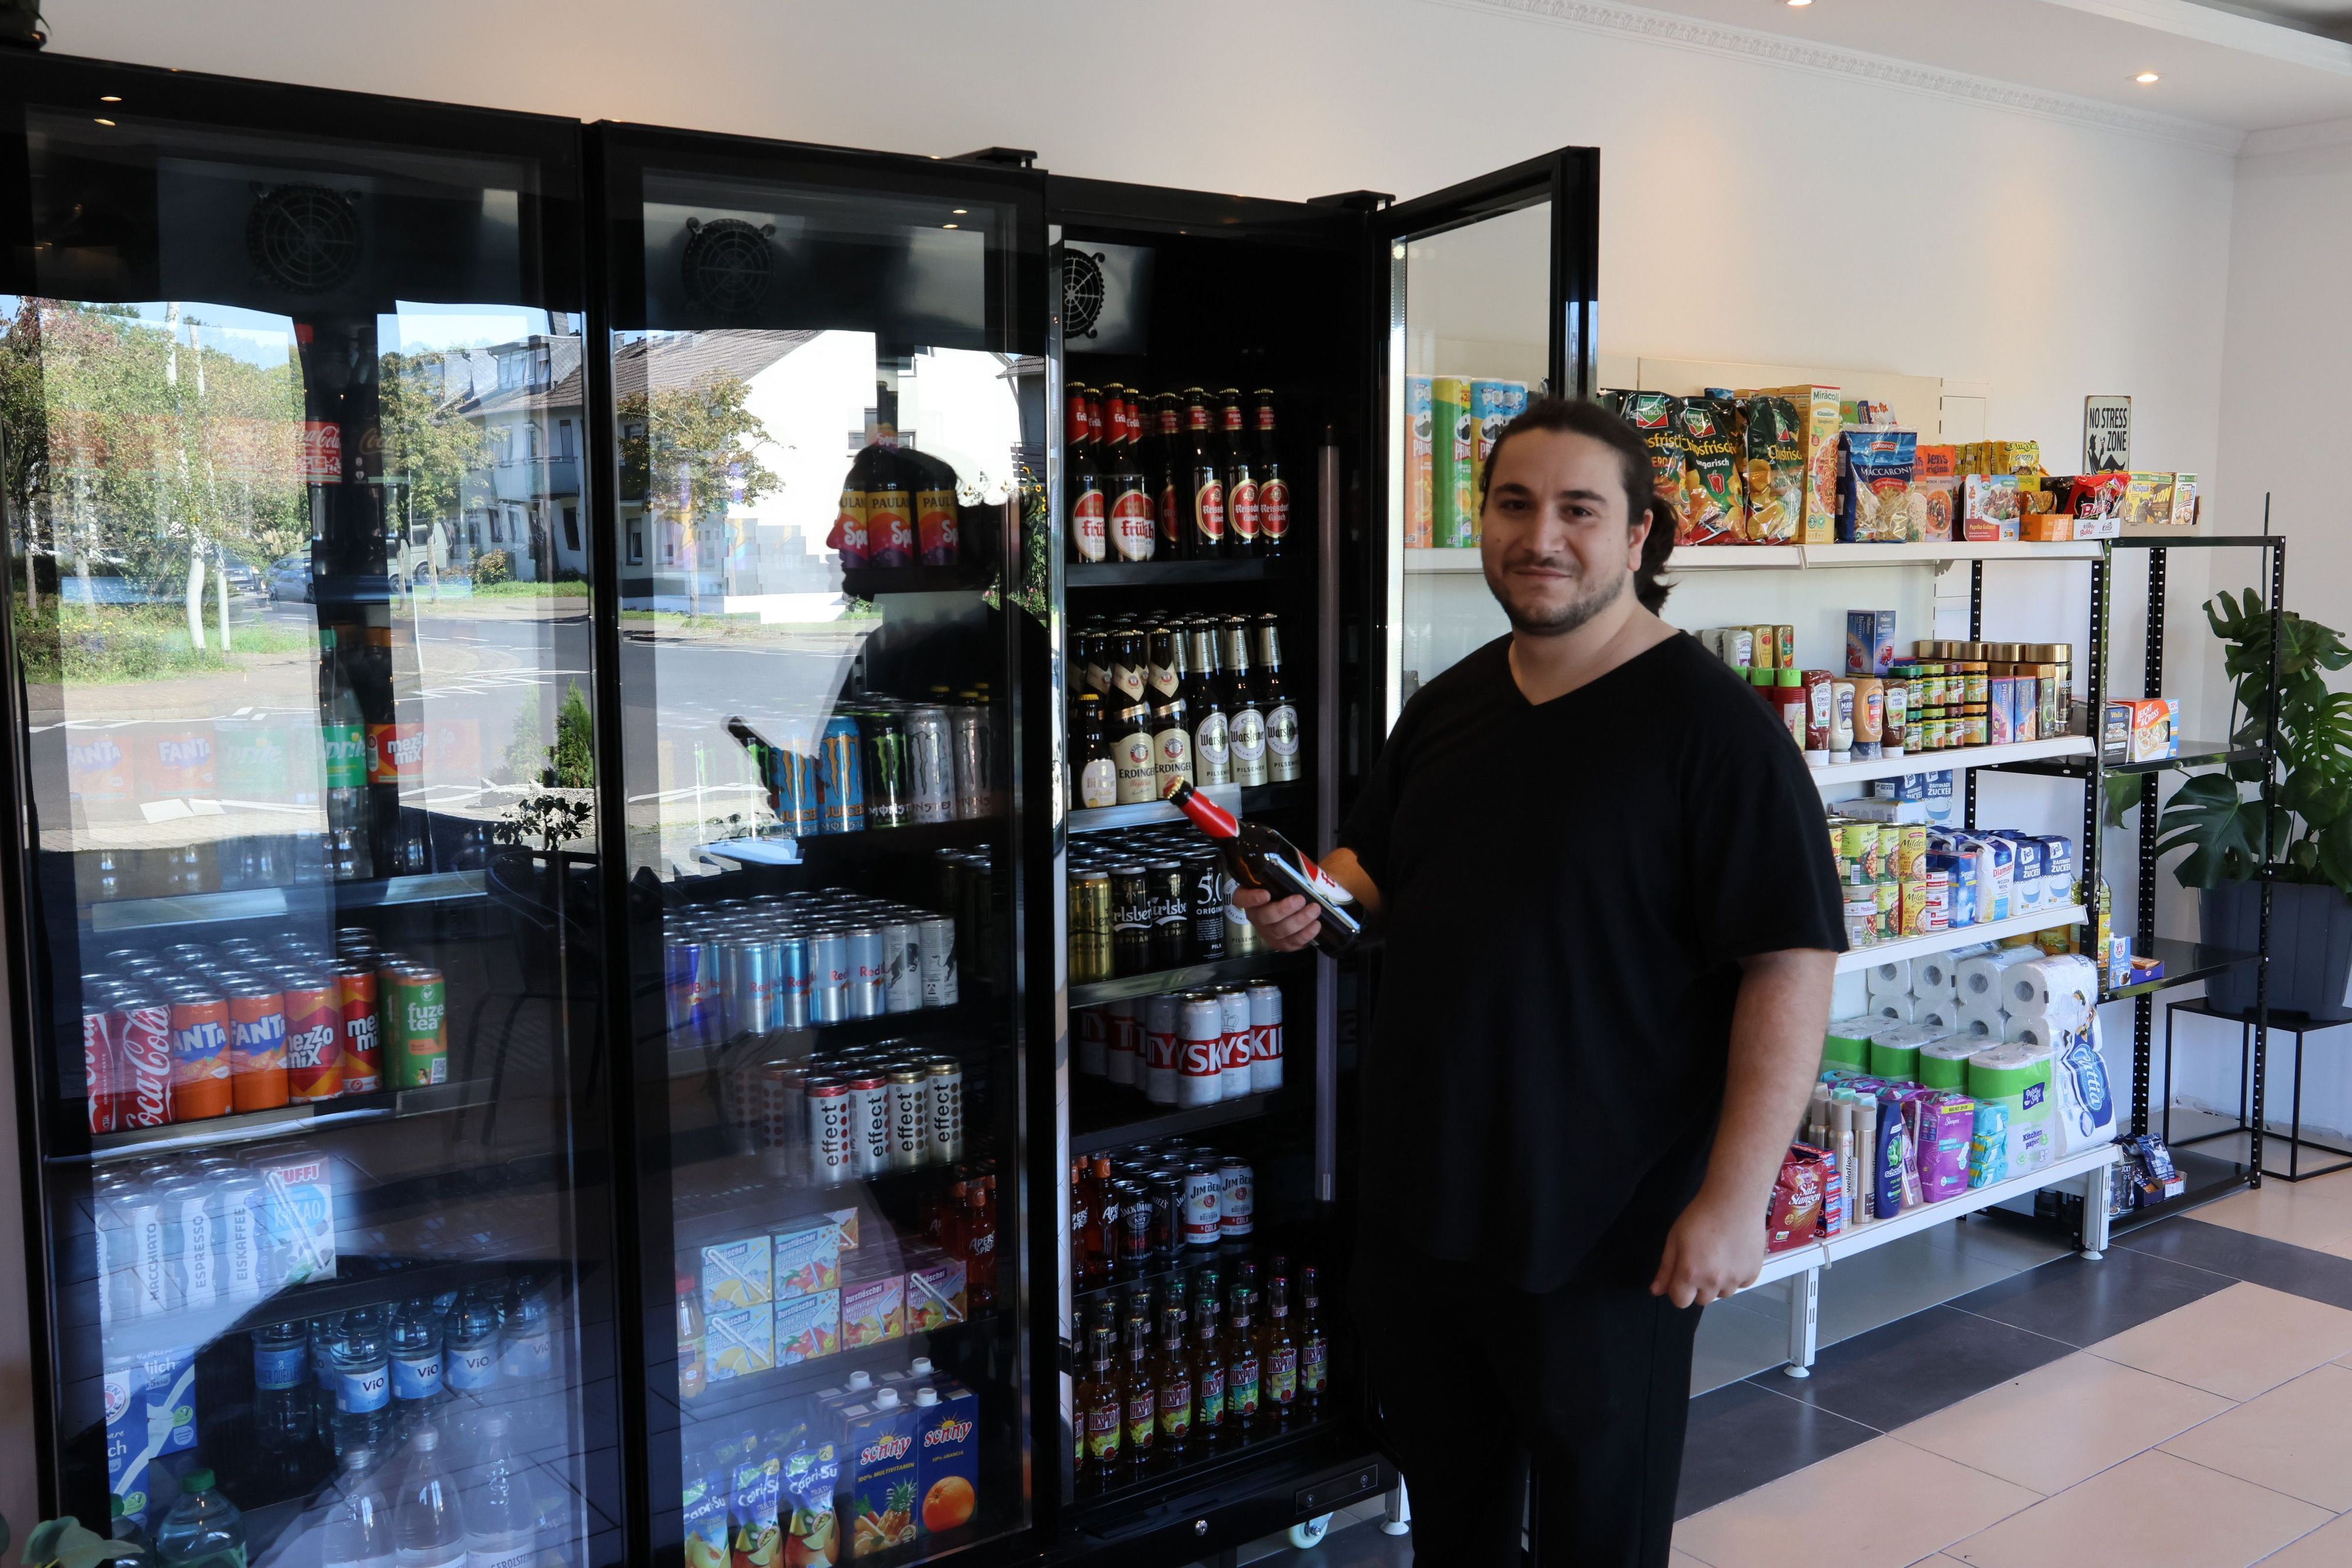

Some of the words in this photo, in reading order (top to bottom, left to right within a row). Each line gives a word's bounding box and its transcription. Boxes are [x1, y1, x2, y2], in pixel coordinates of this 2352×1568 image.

[1813, 390, 1839, 403] Mirácoli
[2089, 407, 2100, 429] NO
[2101, 407, 2127, 429] STRESS
[2107, 430, 2127, 452] ZONE
[1696, 457, 1729, 470] ungarisch
[2132, 484, 2150, 493] Nesquik
[2137, 703, 2153, 723] LEICHT
[2140, 708, 2160, 727] &CROSS
[2107, 722, 2126, 731] PROTEIN+
[1230, 729, 1264, 743] Warsteiner
[394, 748, 423, 766] mix
[2023, 847, 2032, 861] ja!
[2053, 842, 2061, 856] ja!
[1993, 862, 2014, 878] Diamant
[831, 969, 848, 981] Red
[408, 1002, 444, 1019] fuze
[409, 1017, 437, 1032] tea
[898, 1092, 913, 1152] effect
[934, 1084, 949, 1143] effect
[868, 1095, 883, 1158] effect
[822, 1104, 838, 1167] effect
[2023, 1129, 2043, 1142] Kitchen
[2026, 1138, 2040, 1150] paper
[1191, 1185, 1206, 1199] JIM
[1222, 1178, 1238, 1192] JIM
[1789, 1193, 1821, 1206] Stangen
[1236, 1216, 1250, 1225] COLA
[193, 1215, 205, 1289] ESPRESSO
[234, 1207, 247, 1281] EISKAFFEE
[146, 1223, 158, 1301] MACCHIATO
[846, 1285, 883, 1305] Durstlöscher
[924, 1421, 972, 1447] sonny
[860, 1436, 911, 1466] sonny
[858, 1473, 873, 1483] 100%
[873, 1462, 915, 1477] MULTIVITAMIN
